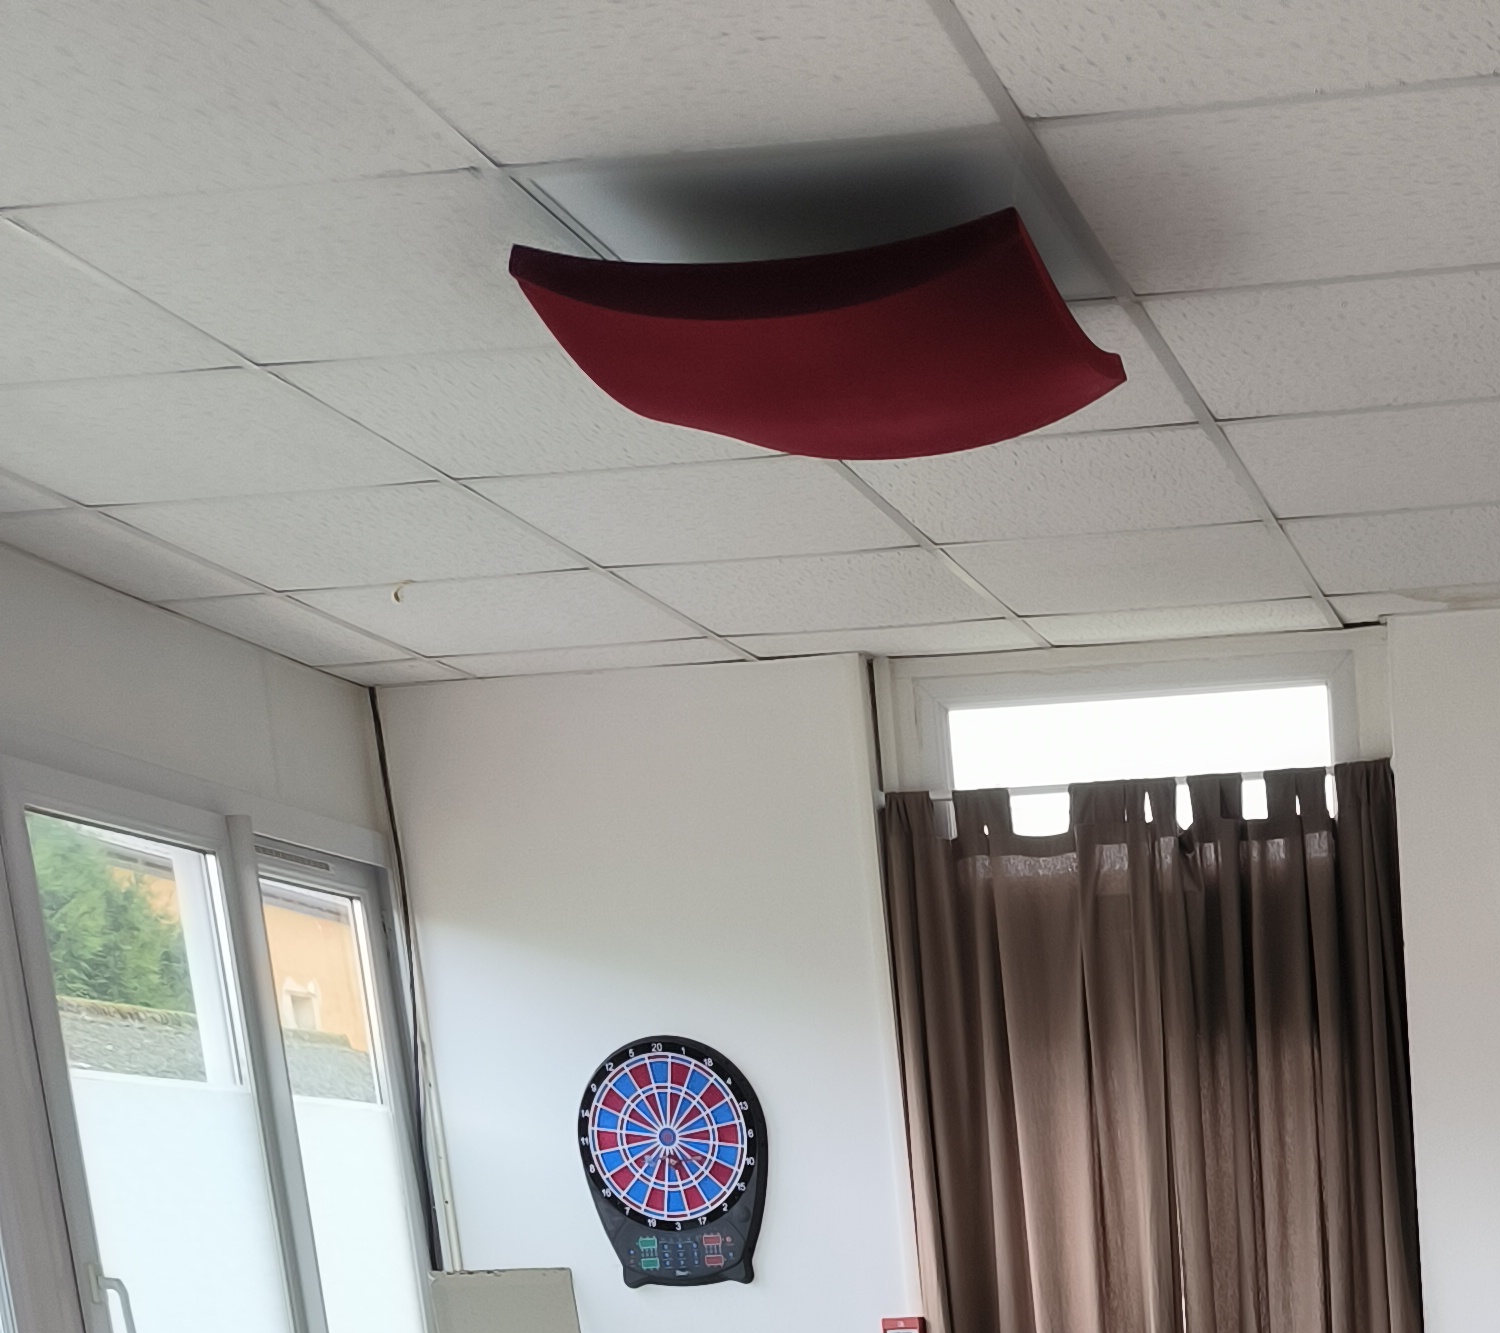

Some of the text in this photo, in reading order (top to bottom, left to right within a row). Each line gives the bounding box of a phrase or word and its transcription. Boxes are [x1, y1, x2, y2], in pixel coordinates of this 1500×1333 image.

[651, 1043, 663, 1052] 20
[628, 1049, 635, 1058] 5
[703, 1058, 714, 1067] 18
[605, 1063, 614, 1072] 12
[590, 1084, 597, 1093] 9
[738, 1101, 749, 1111] 13
[581, 1109, 590, 1118] 14
[580, 1137, 590, 1146] 11
[745, 1157, 755, 1166] 10
[722, 1202, 729, 1212] 2
[647, 1219, 657, 1228] 19
[675, 1221, 682, 1231] 3
[698, 1217, 707, 1226] 17
